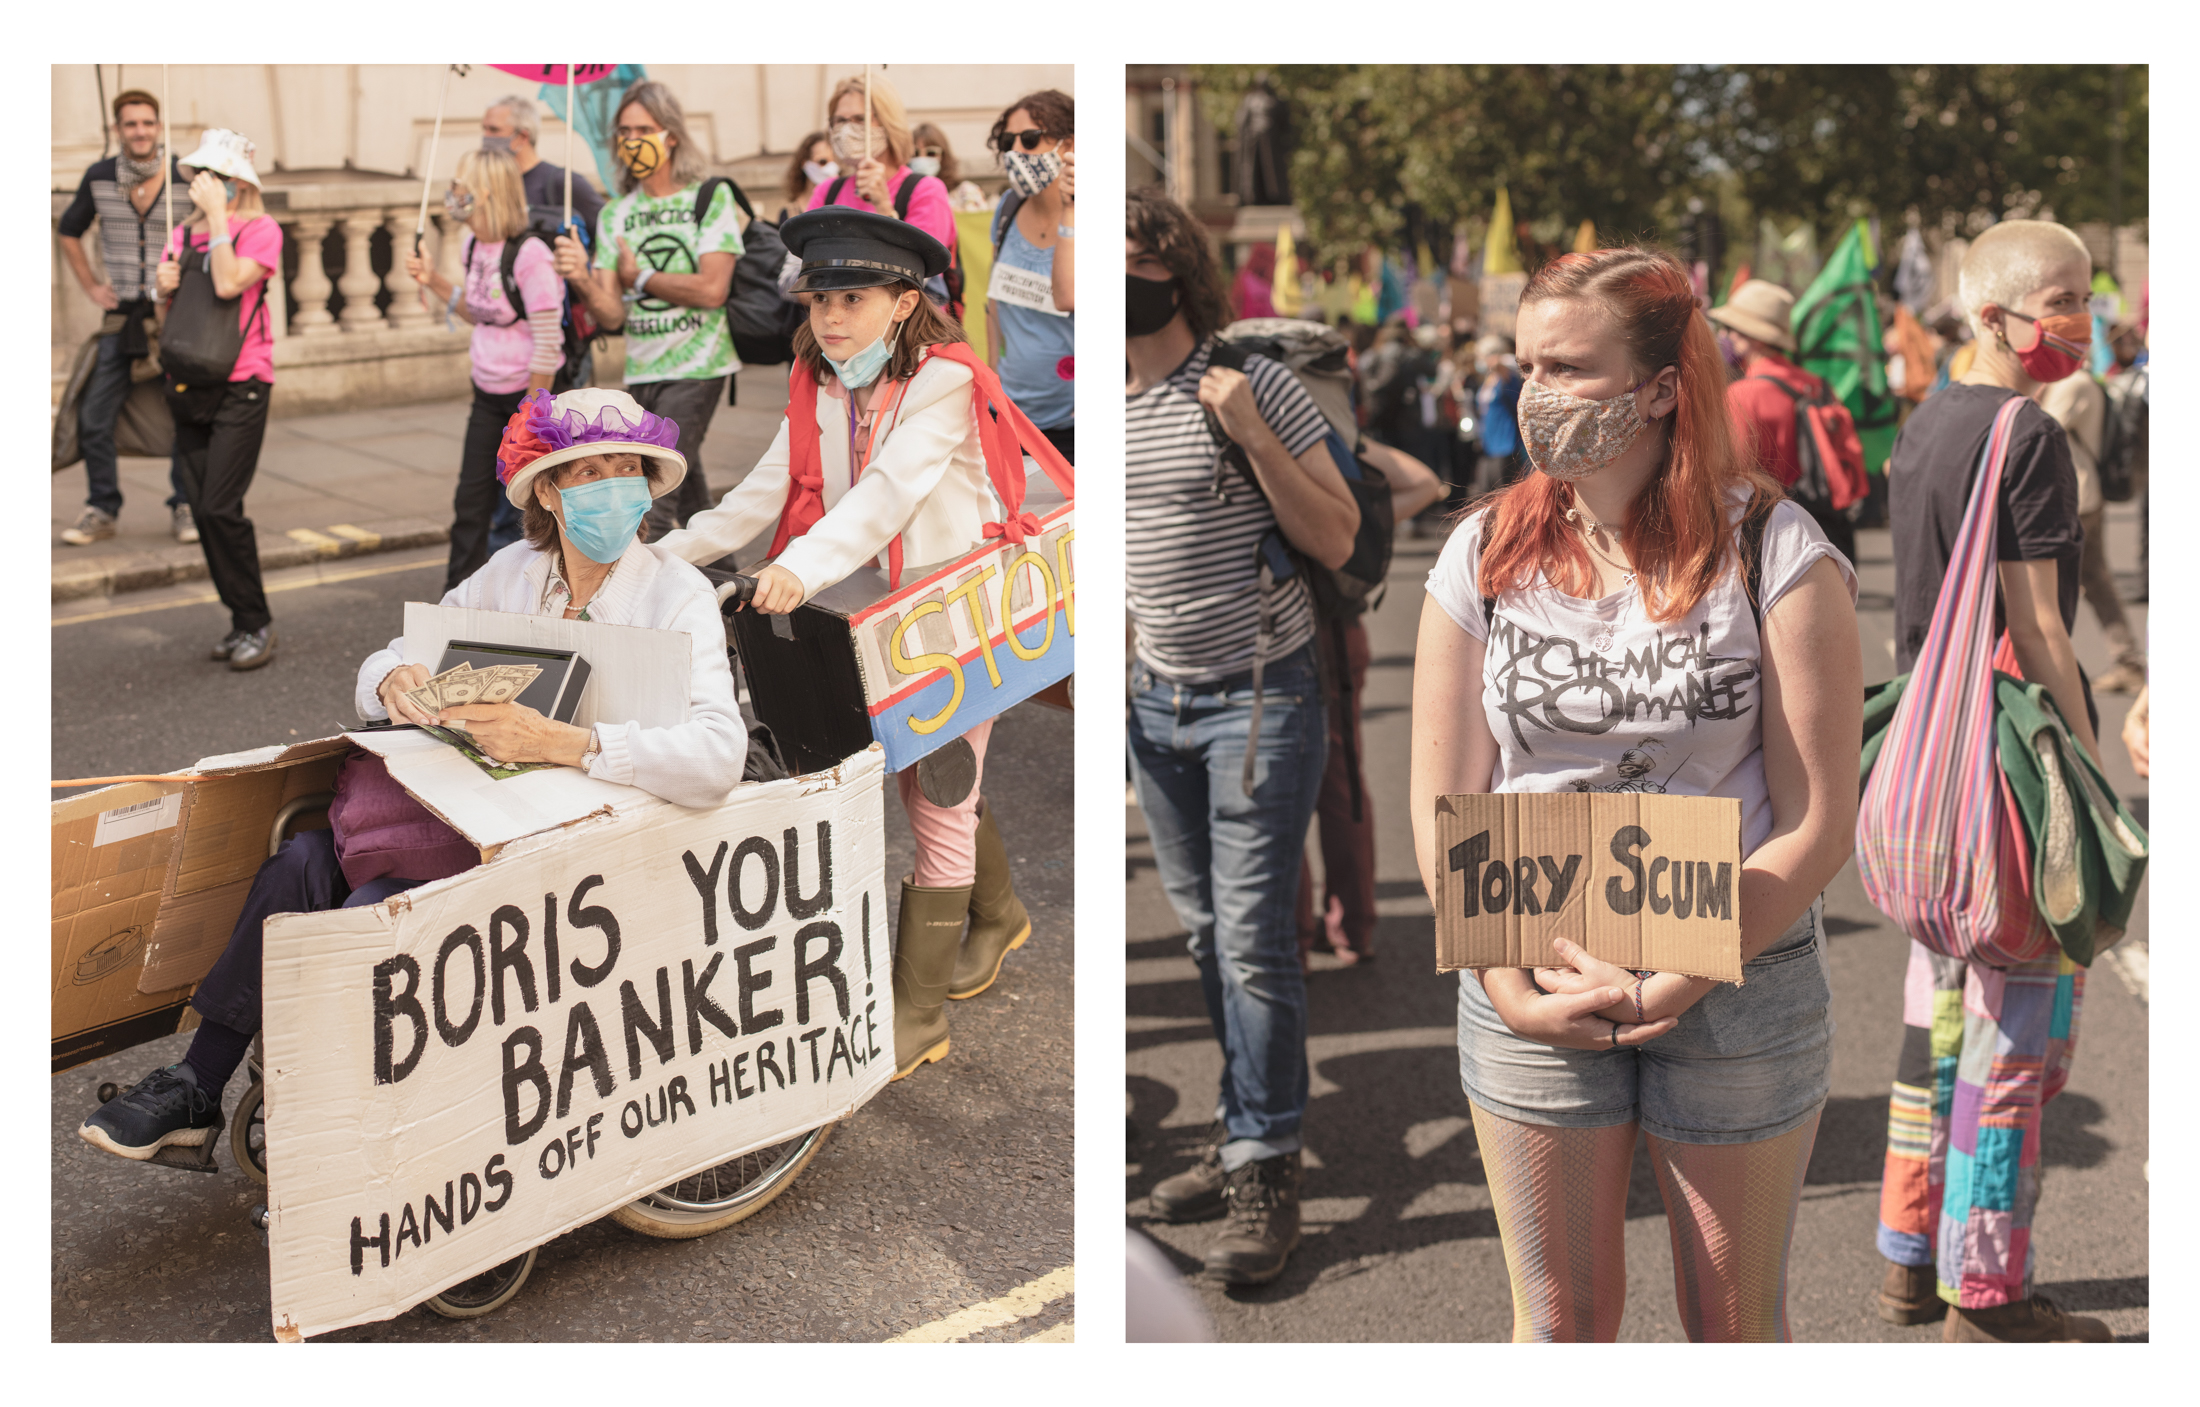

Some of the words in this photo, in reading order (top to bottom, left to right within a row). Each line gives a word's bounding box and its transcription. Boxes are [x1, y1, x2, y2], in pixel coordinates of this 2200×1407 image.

[372, 874, 621, 1087] BORIS
[681, 820, 834, 947] YOU
[1448, 829, 1582, 919] TORY
[1605, 825, 1732, 921] SCUM
[350, 1153, 514, 1277] HANDS
[538, 1111, 605, 1181] OFF
[620, 1075, 697, 1139] OUR
[709, 1000, 881, 1108] HERITAGE
[501, 890, 874, 1146] BANKER!
